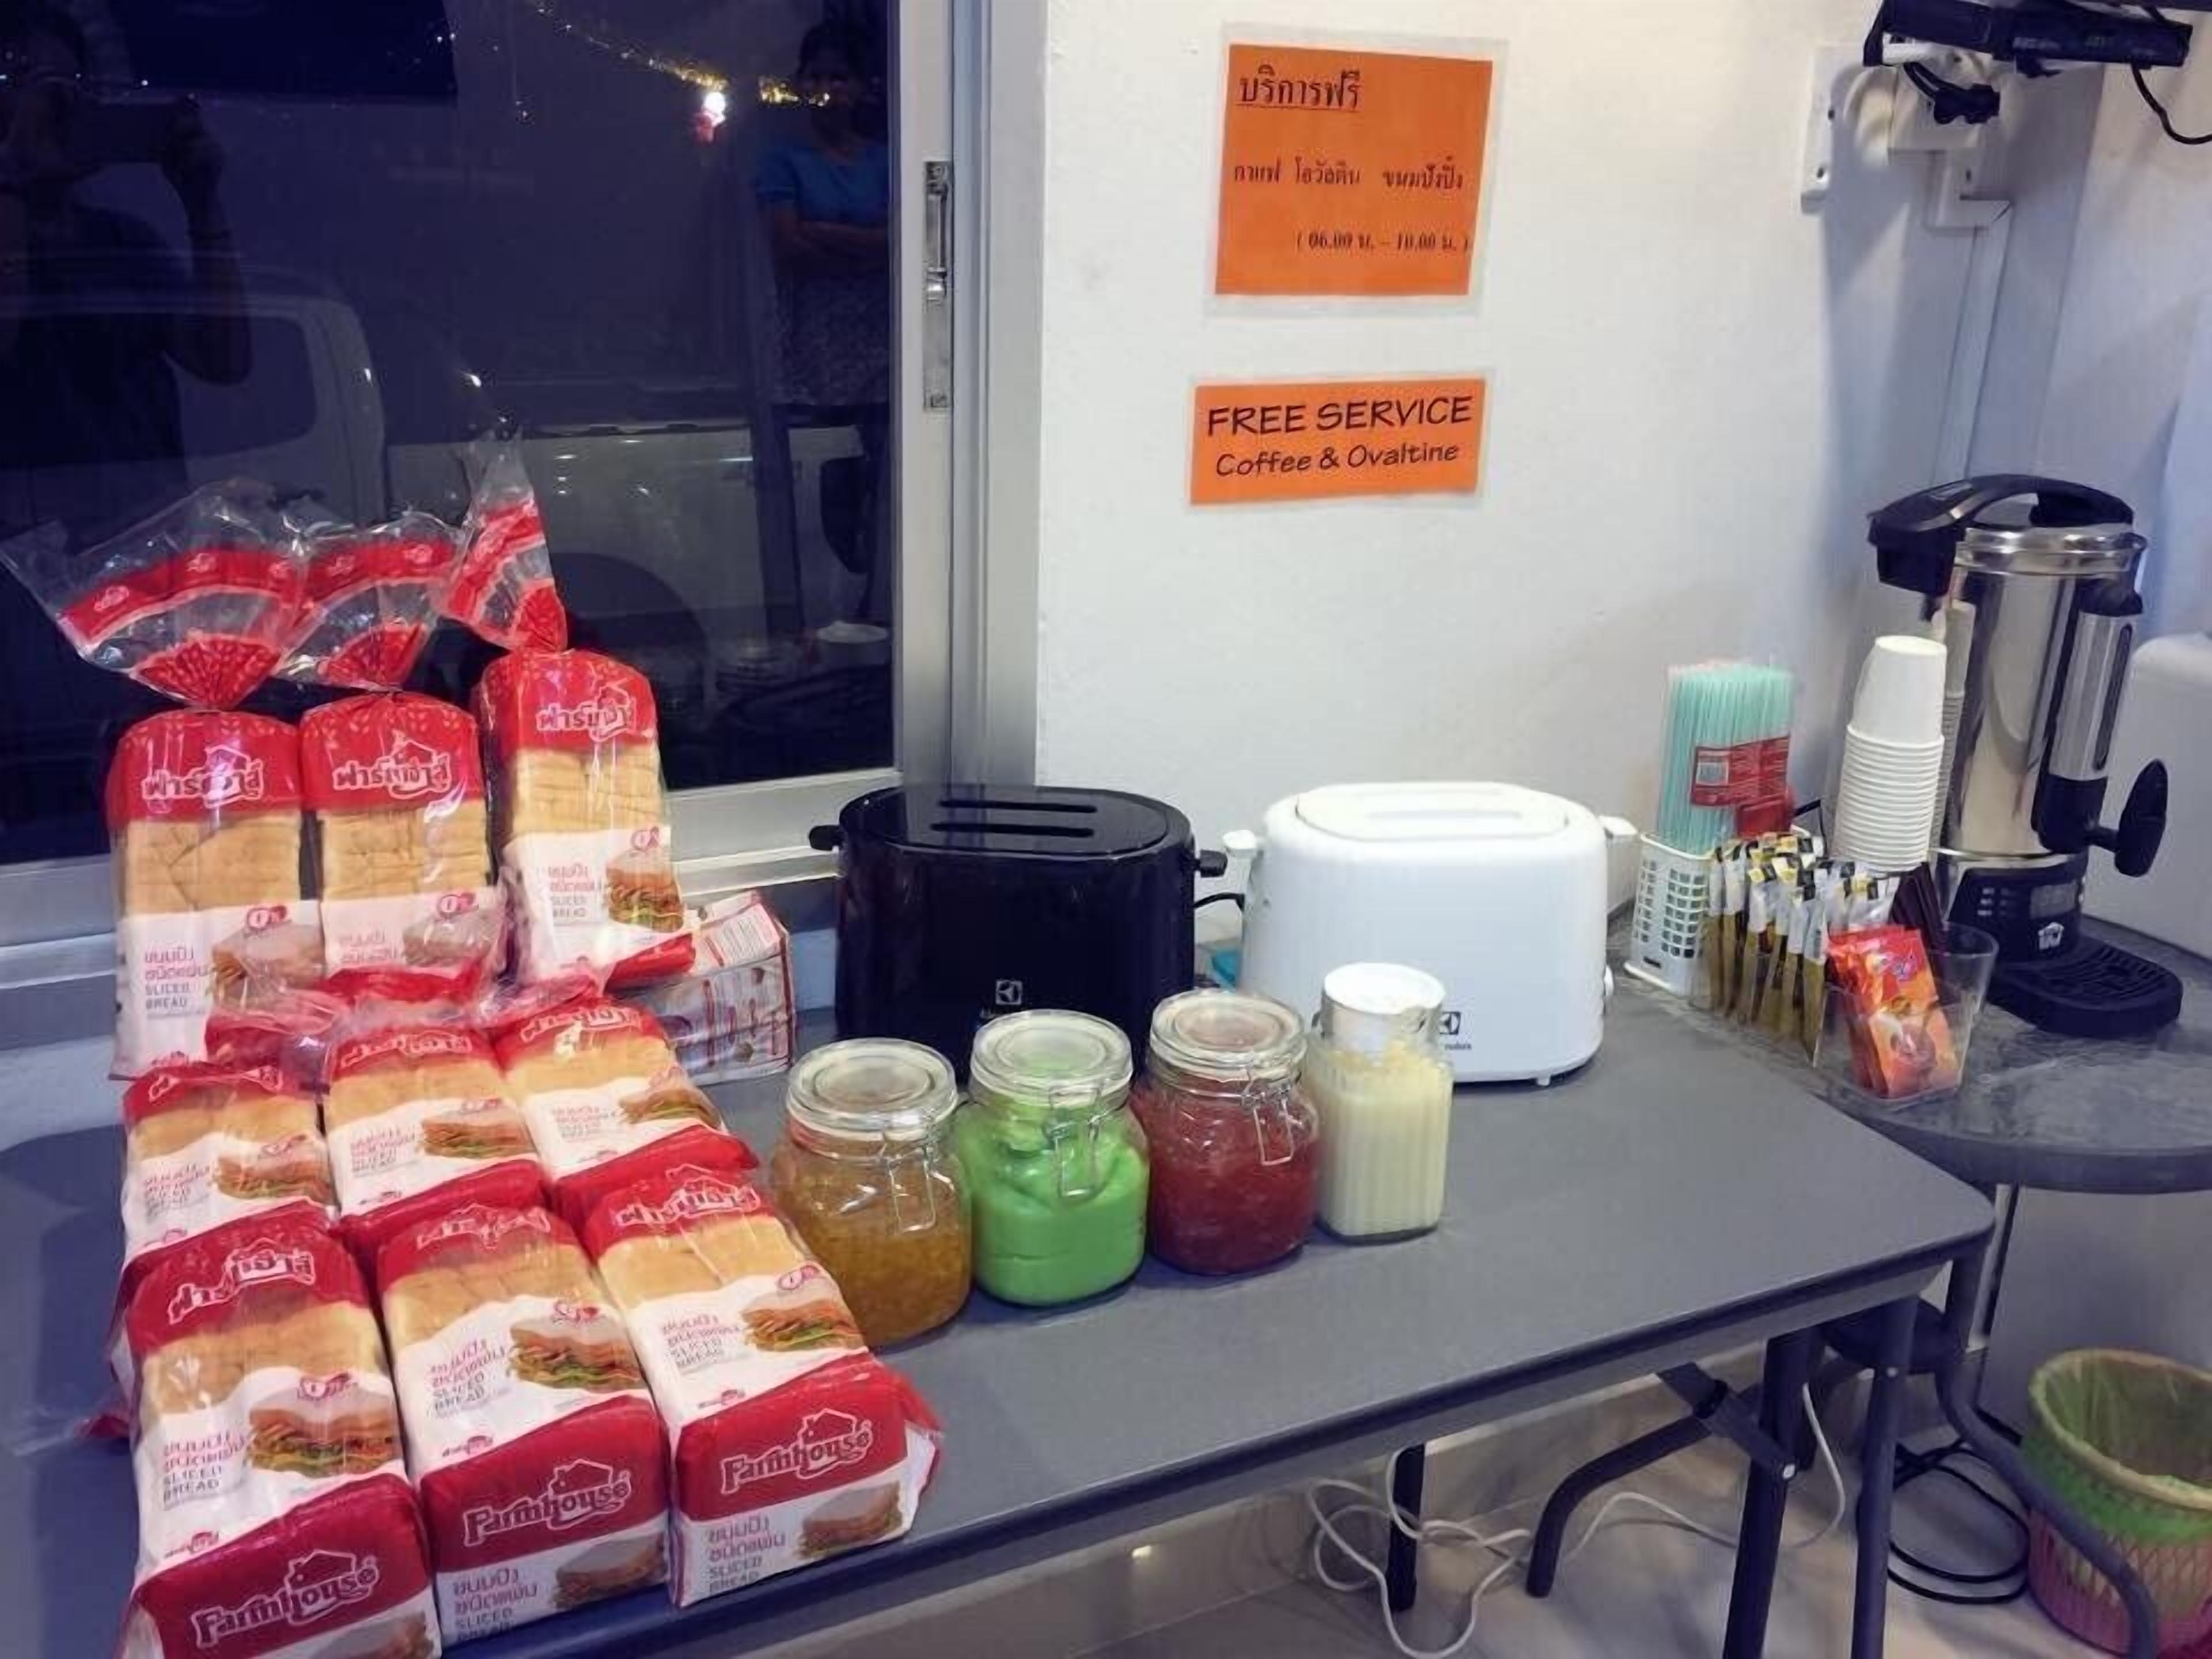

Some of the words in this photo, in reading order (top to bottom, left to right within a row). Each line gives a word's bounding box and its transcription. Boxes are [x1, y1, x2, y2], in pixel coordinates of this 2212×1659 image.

[1240, 65, 1361, 109] บริการฟรี
[1207, 404, 1307, 436] FREE
[1315, 396, 1472, 431] SERVICE
[1215, 450, 1311, 476] Coffee
[1319, 447, 1340, 469] &
[1347, 442, 1459, 468] Ovaltine
